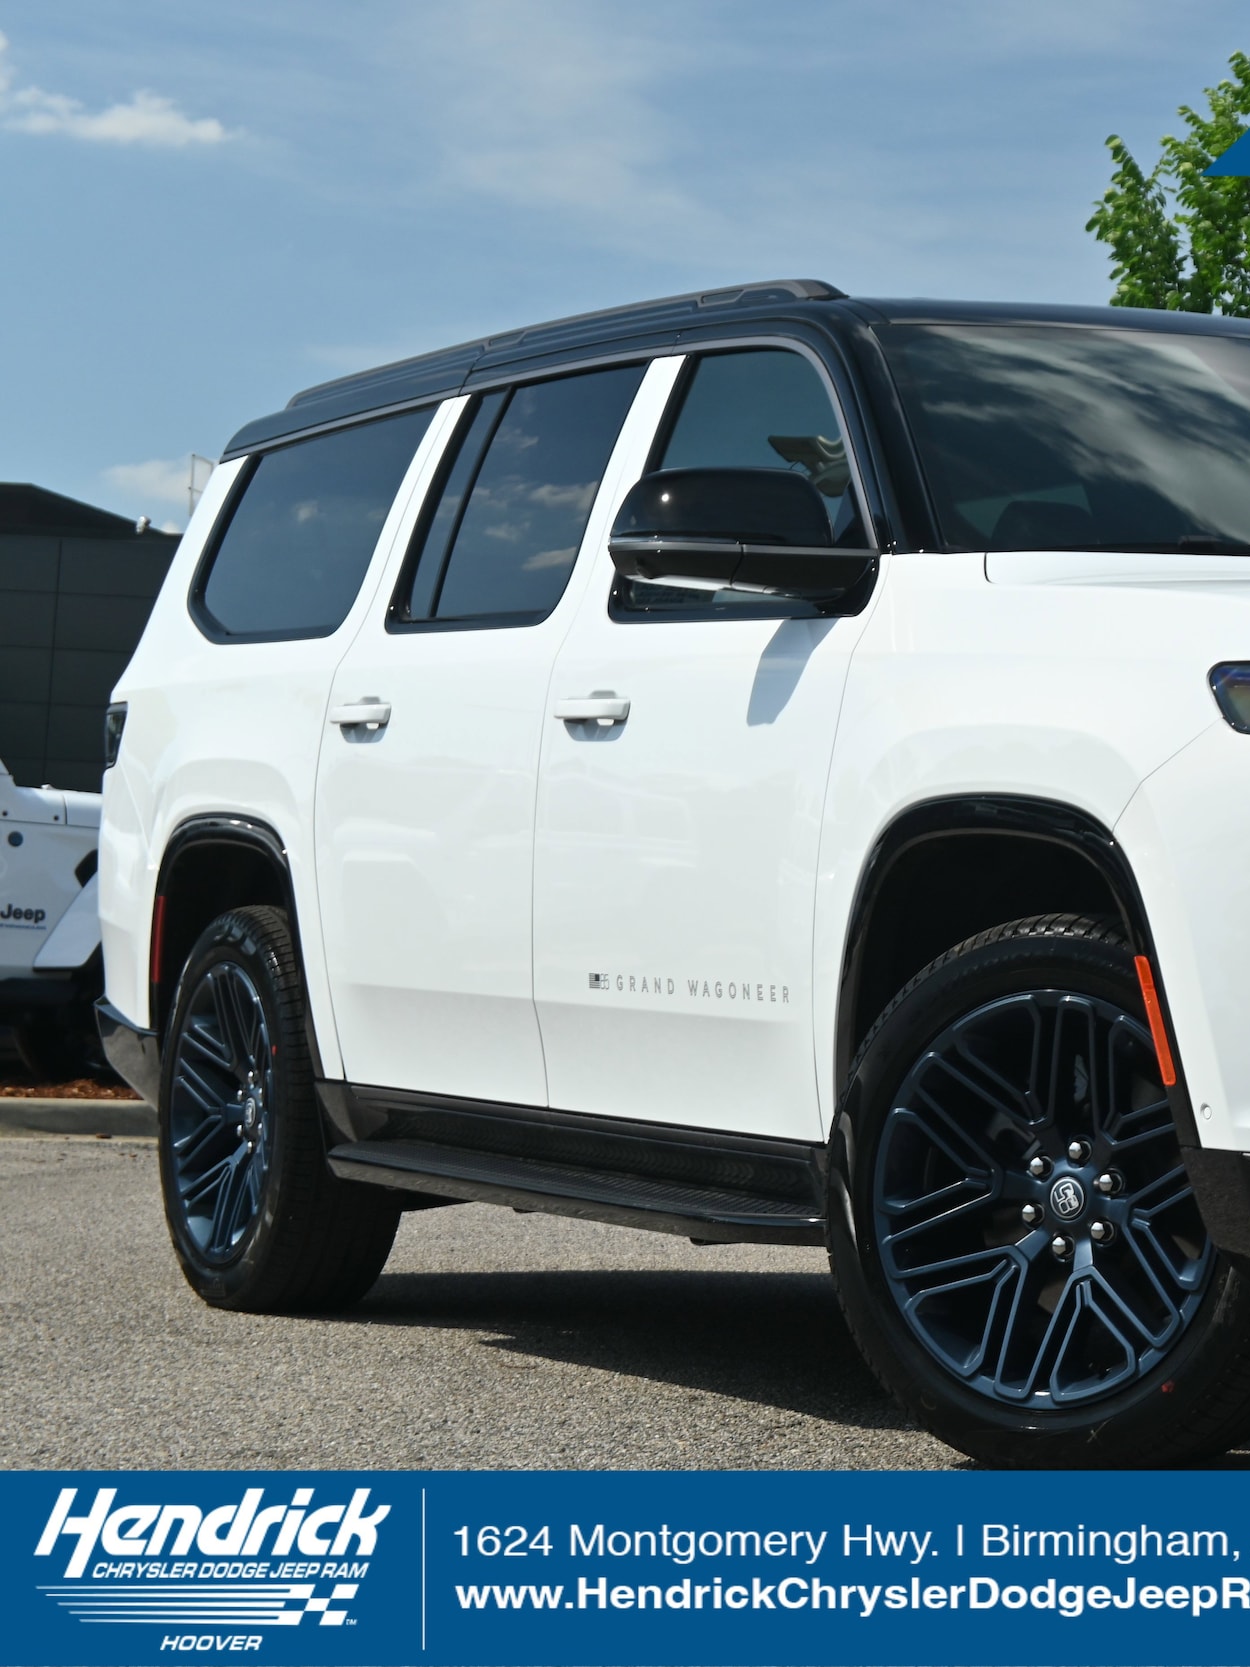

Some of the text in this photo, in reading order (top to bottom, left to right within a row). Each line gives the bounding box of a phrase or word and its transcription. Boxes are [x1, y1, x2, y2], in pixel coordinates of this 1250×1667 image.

[0, 903, 46, 924] Jeep
[616, 974, 790, 1003] GRAND WAGONEER
